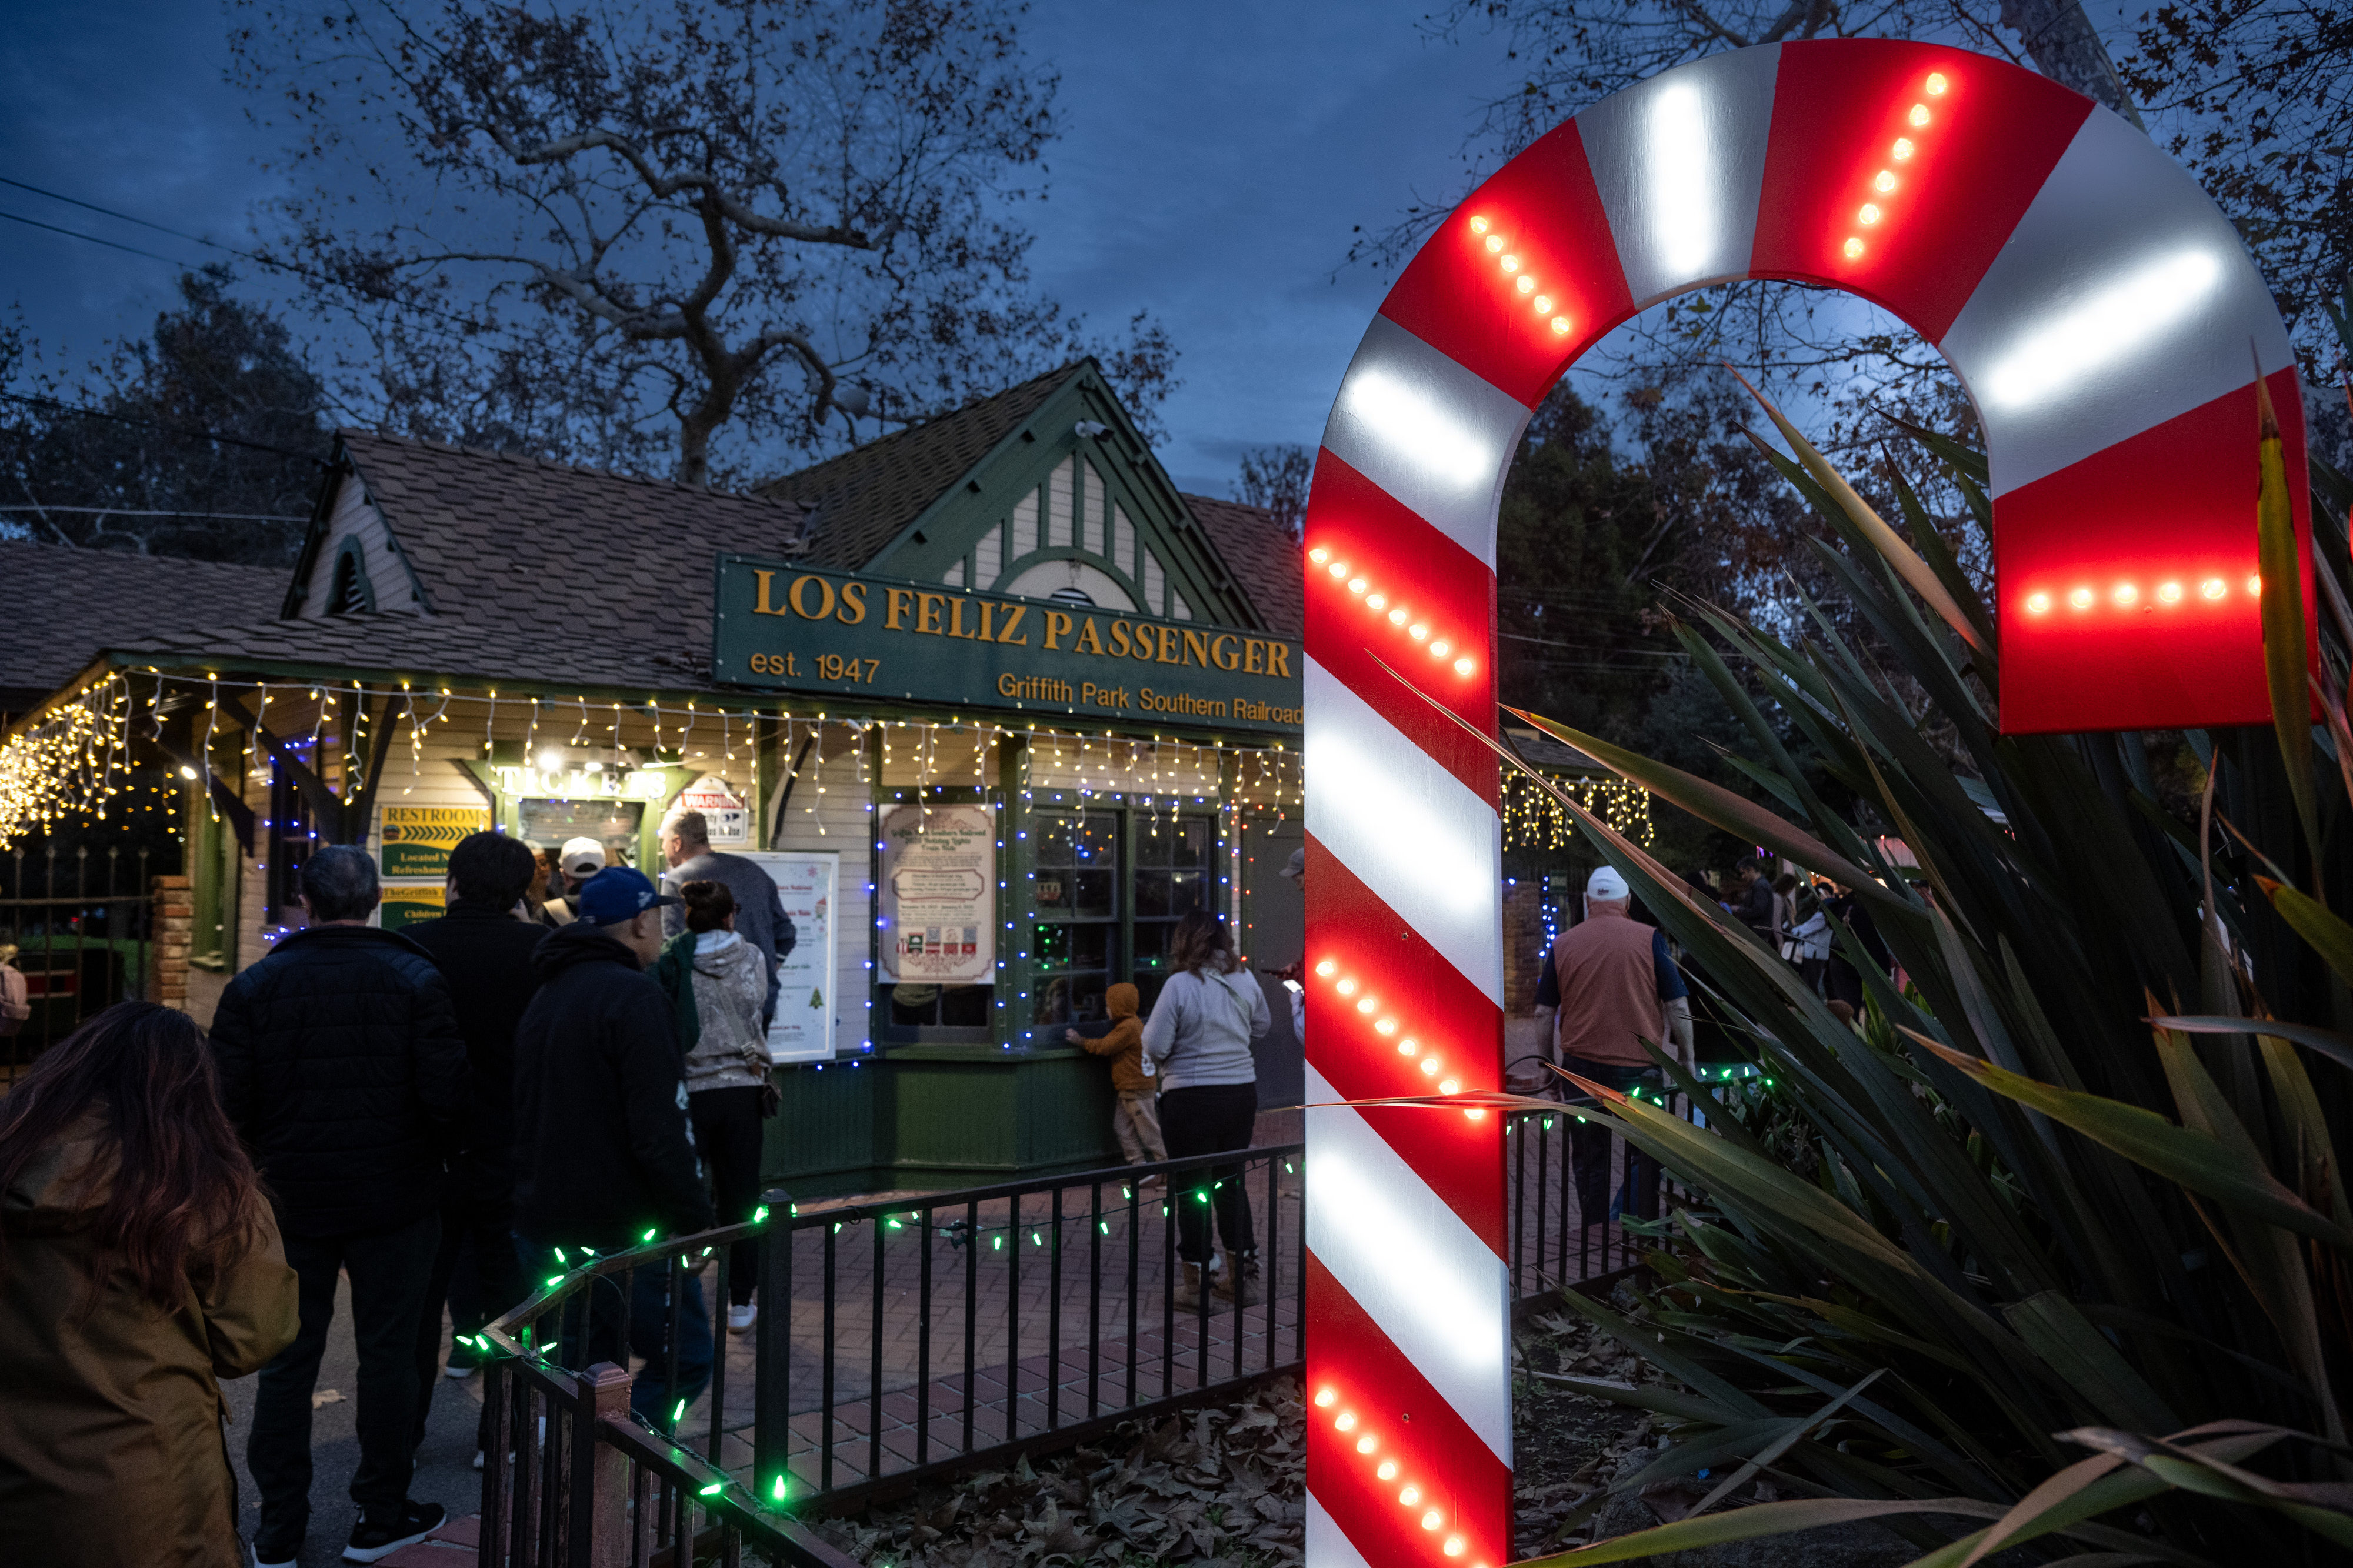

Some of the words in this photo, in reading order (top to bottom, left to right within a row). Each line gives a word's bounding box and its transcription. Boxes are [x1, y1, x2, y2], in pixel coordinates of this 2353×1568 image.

[754, 569, 866, 625] LOS
[884, 588, 1027, 645] FELIZ
[1043, 610, 1291, 678] PASSENGER
[750, 652, 801, 676] est.
[815, 654, 880, 684] 1947
[998, 673, 1072, 703] Griffith
[1082, 682, 1129, 709] Park
[1139, 688, 1226, 717] Southern
[1233, 698, 1303, 725] Railroad
[496, 766, 666, 798] TICKETS
[684, 794, 742, 808] WARNING
[388, 808, 488, 822] RESTROOMS
[401, 853, 439, 862] Located
[392, 865, 448, 875] Refreshmen
